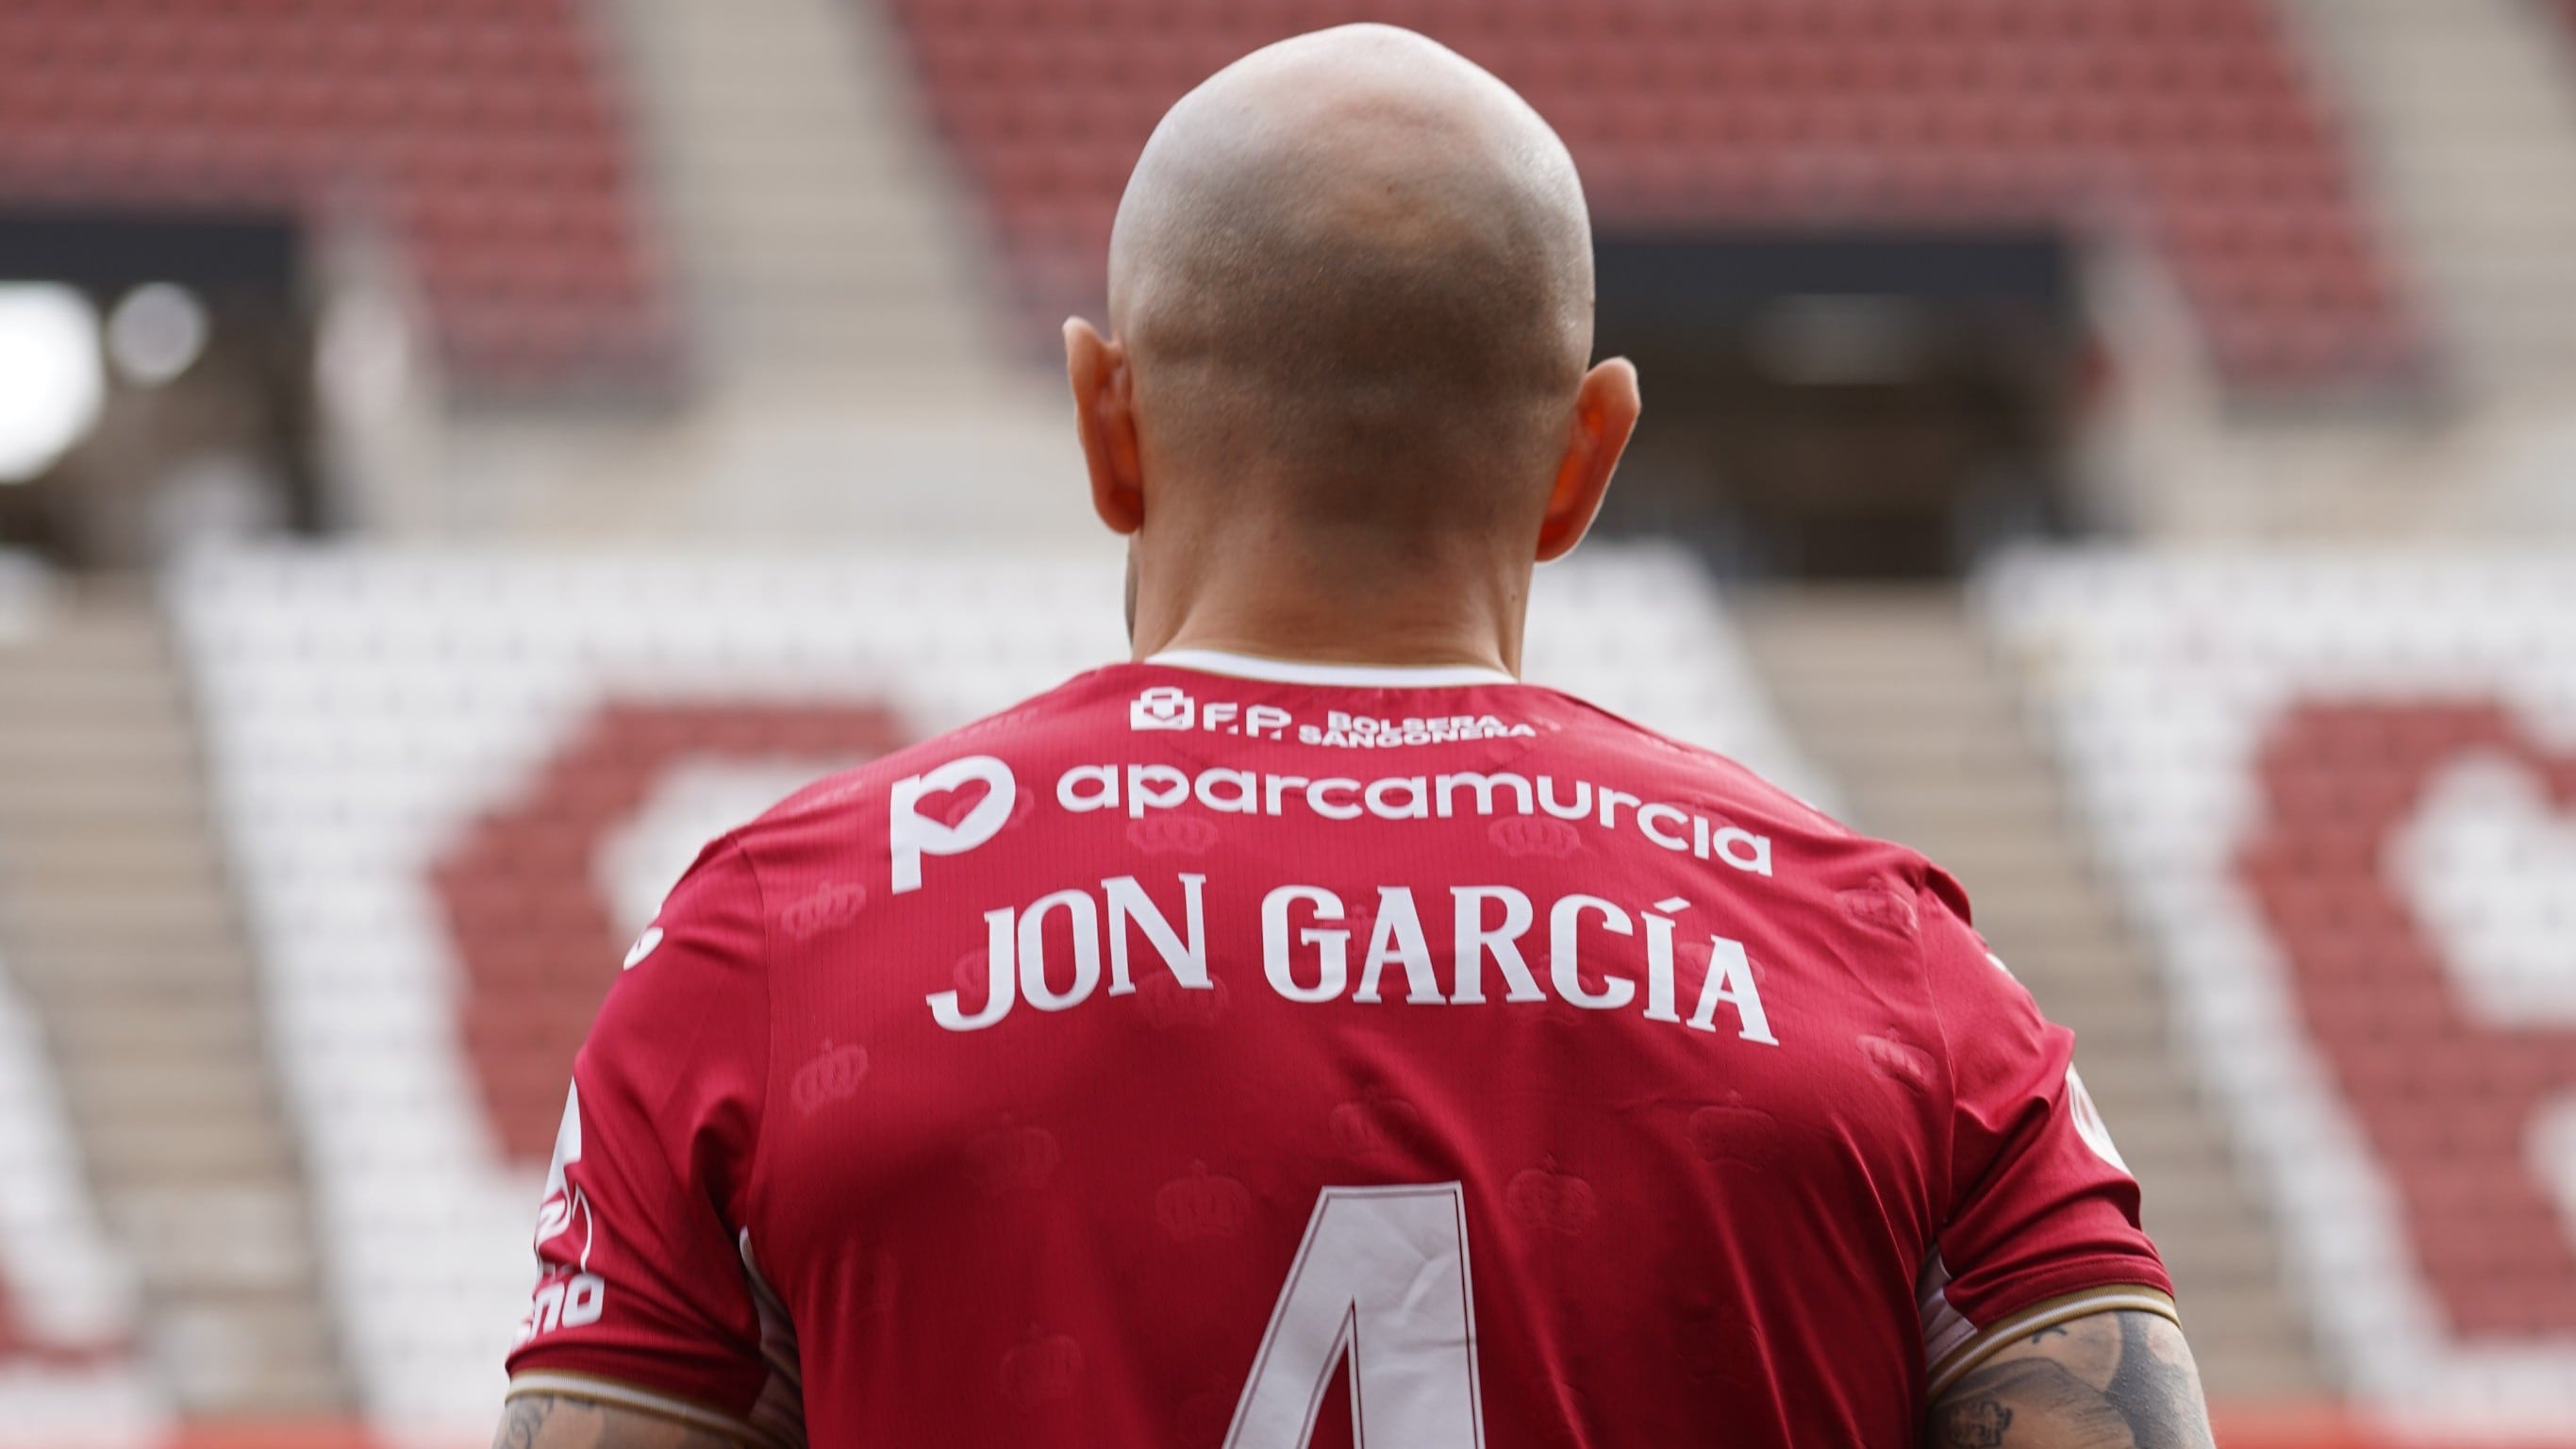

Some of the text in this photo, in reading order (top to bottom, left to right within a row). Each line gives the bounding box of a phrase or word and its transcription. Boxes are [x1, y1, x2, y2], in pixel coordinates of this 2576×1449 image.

[1298, 723, 1537, 748] SANGONERA
[1326, 710, 1503, 736] BOLSERA
[1056, 764, 1774, 878] aparcamurcia
[925, 873, 1780, 1046] JON GARCÍA
[1222, 1180, 1486, 1449] 4
